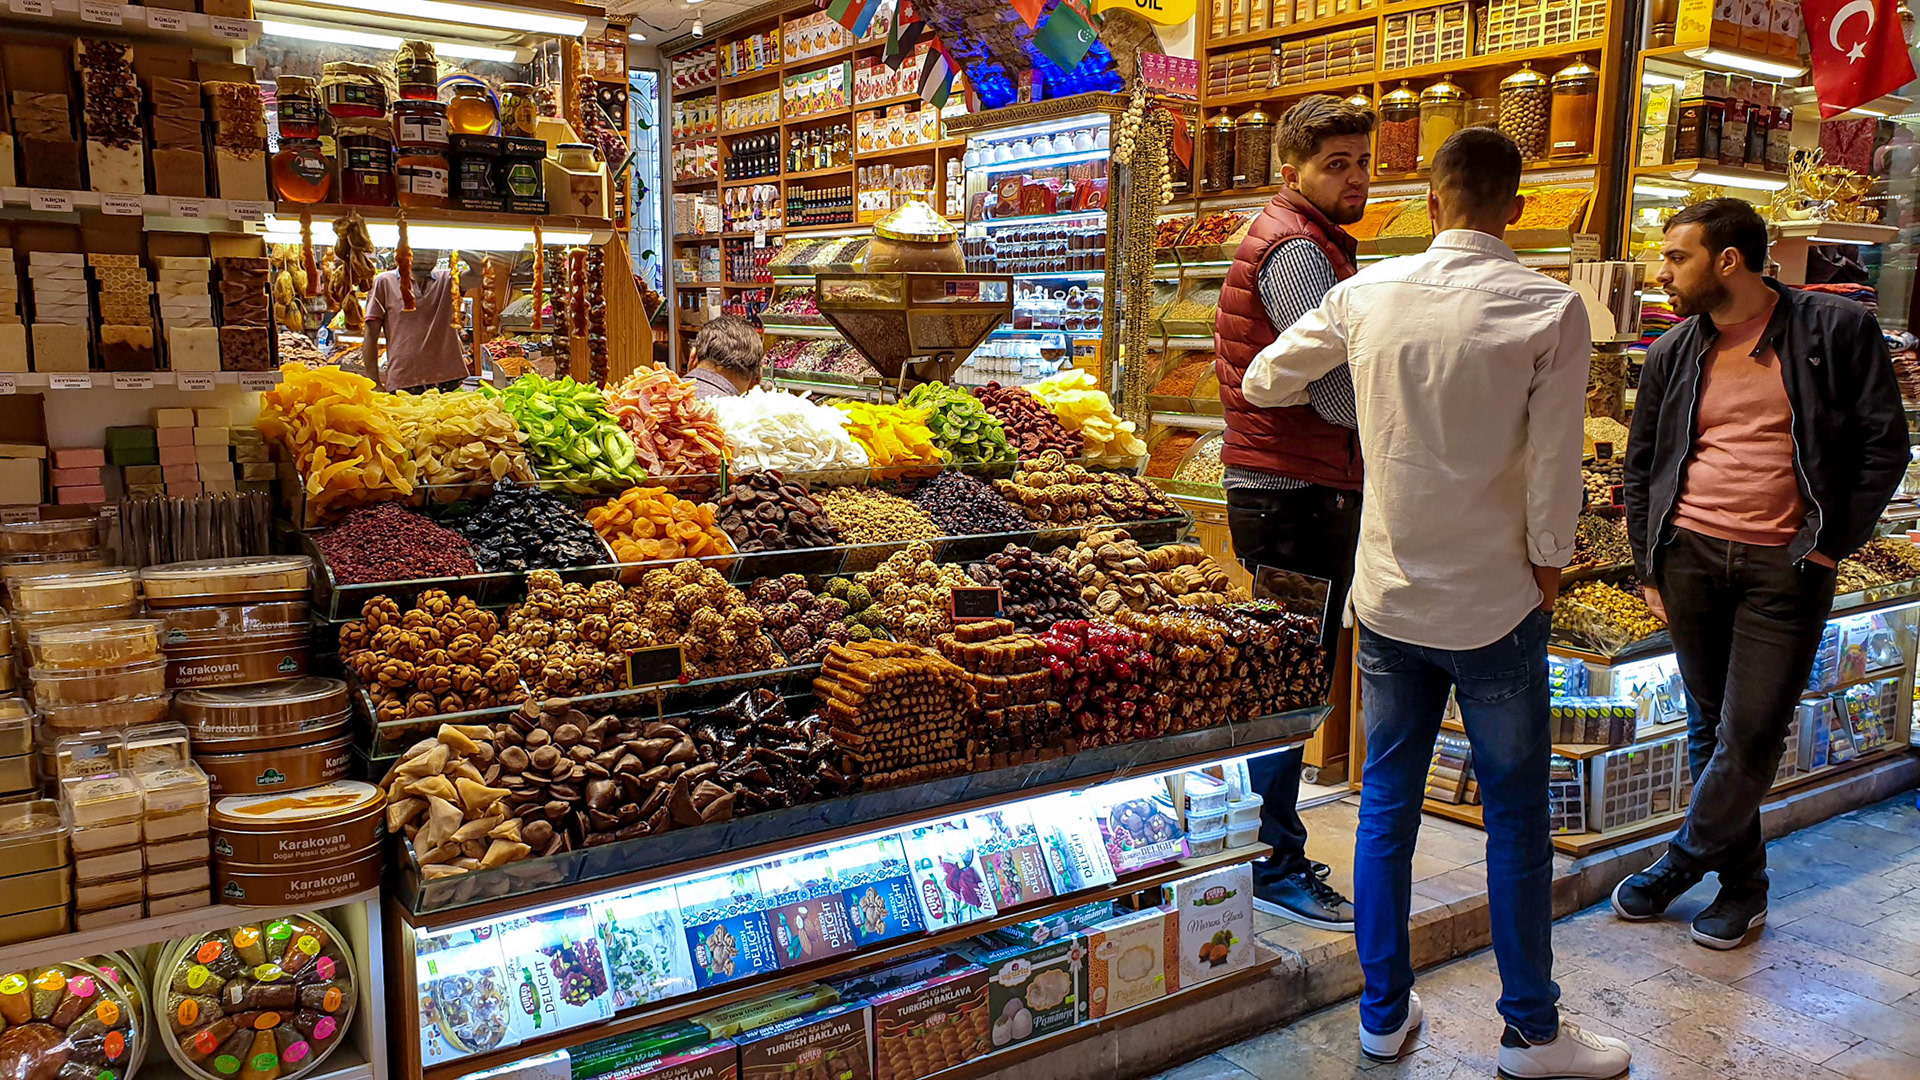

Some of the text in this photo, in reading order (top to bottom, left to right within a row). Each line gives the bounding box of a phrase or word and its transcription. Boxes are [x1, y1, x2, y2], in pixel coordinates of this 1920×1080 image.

[40, 196, 65, 204] TARÇIN
[176, 675, 191, 684] Doğal
[192, 674, 213, 683] Petekli
[179, 662, 240, 676] Karakovan
[325, 753, 351, 769] Karako
[273, 851, 294, 860] Doğal
[294, 848, 319, 858] Petekli
[278, 833, 346, 851] Karakovan
[1075, 834, 1092, 879] DELIGHT
[290, 870, 356, 892] Karakovan
[1022, 851, 1040, 894] DELIGHT
[284, 892, 306, 901] Doğal
[891, 882, 910, 928] DELIGHT
[923, 883, 939, 916] TURKO
[821, 902, 840, 948] DELIGHT
[740, 930, 751, 960] TURKISH
[744, 920, 762, 968] DELIGHT
[534, 962, 556, 1014] DELIGHT
[897, 986, 972, 1017] TURKISH BAKLAVA
[766, 1023, 852, 1057] TURKISH BAKLAVA
[799, 1048, 822, 1061] TURKO
